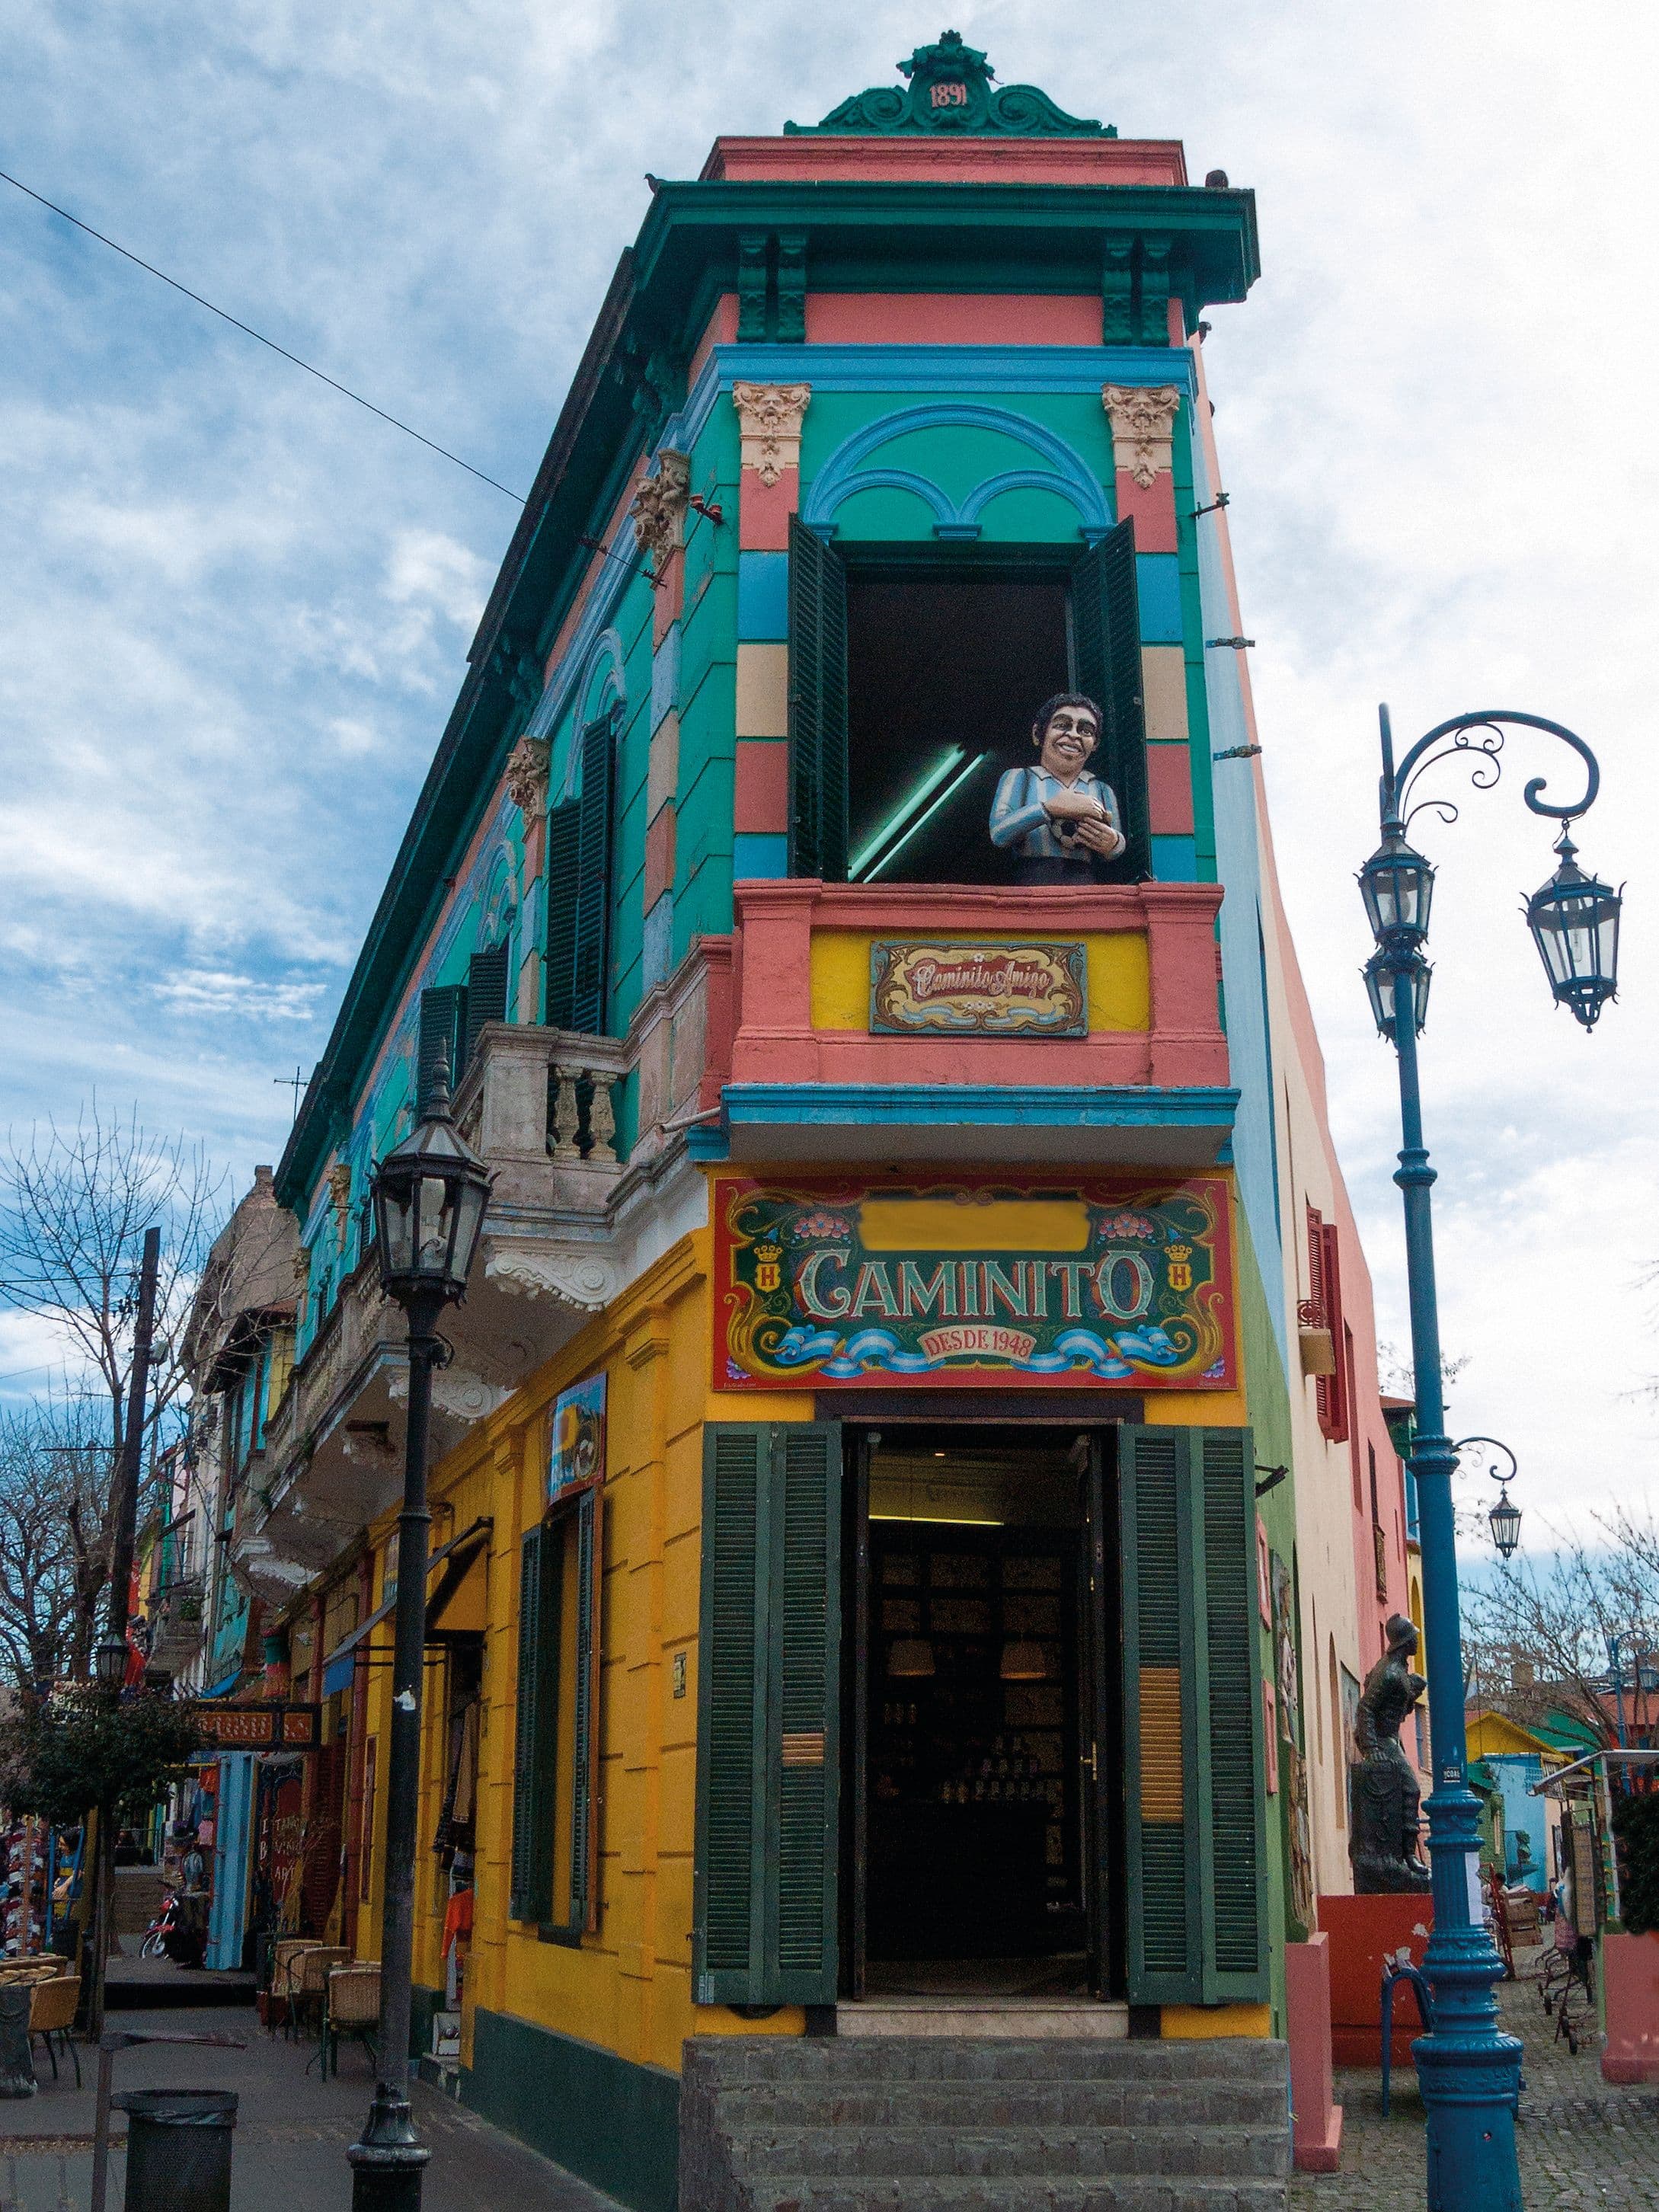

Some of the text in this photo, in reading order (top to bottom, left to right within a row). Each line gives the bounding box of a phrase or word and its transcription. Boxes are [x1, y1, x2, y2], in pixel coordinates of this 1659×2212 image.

[929, 84, 967, 107] 1891
[913, 961, 1050, 999] Caminito Amigo
[760, 1266, 775, 1287] H
[794, 1249, 1156, 1320] CAMINITO
[1172, 1265, 1188, 1287] H
[924, 1329, 1032, 1357] DESDE 1948
